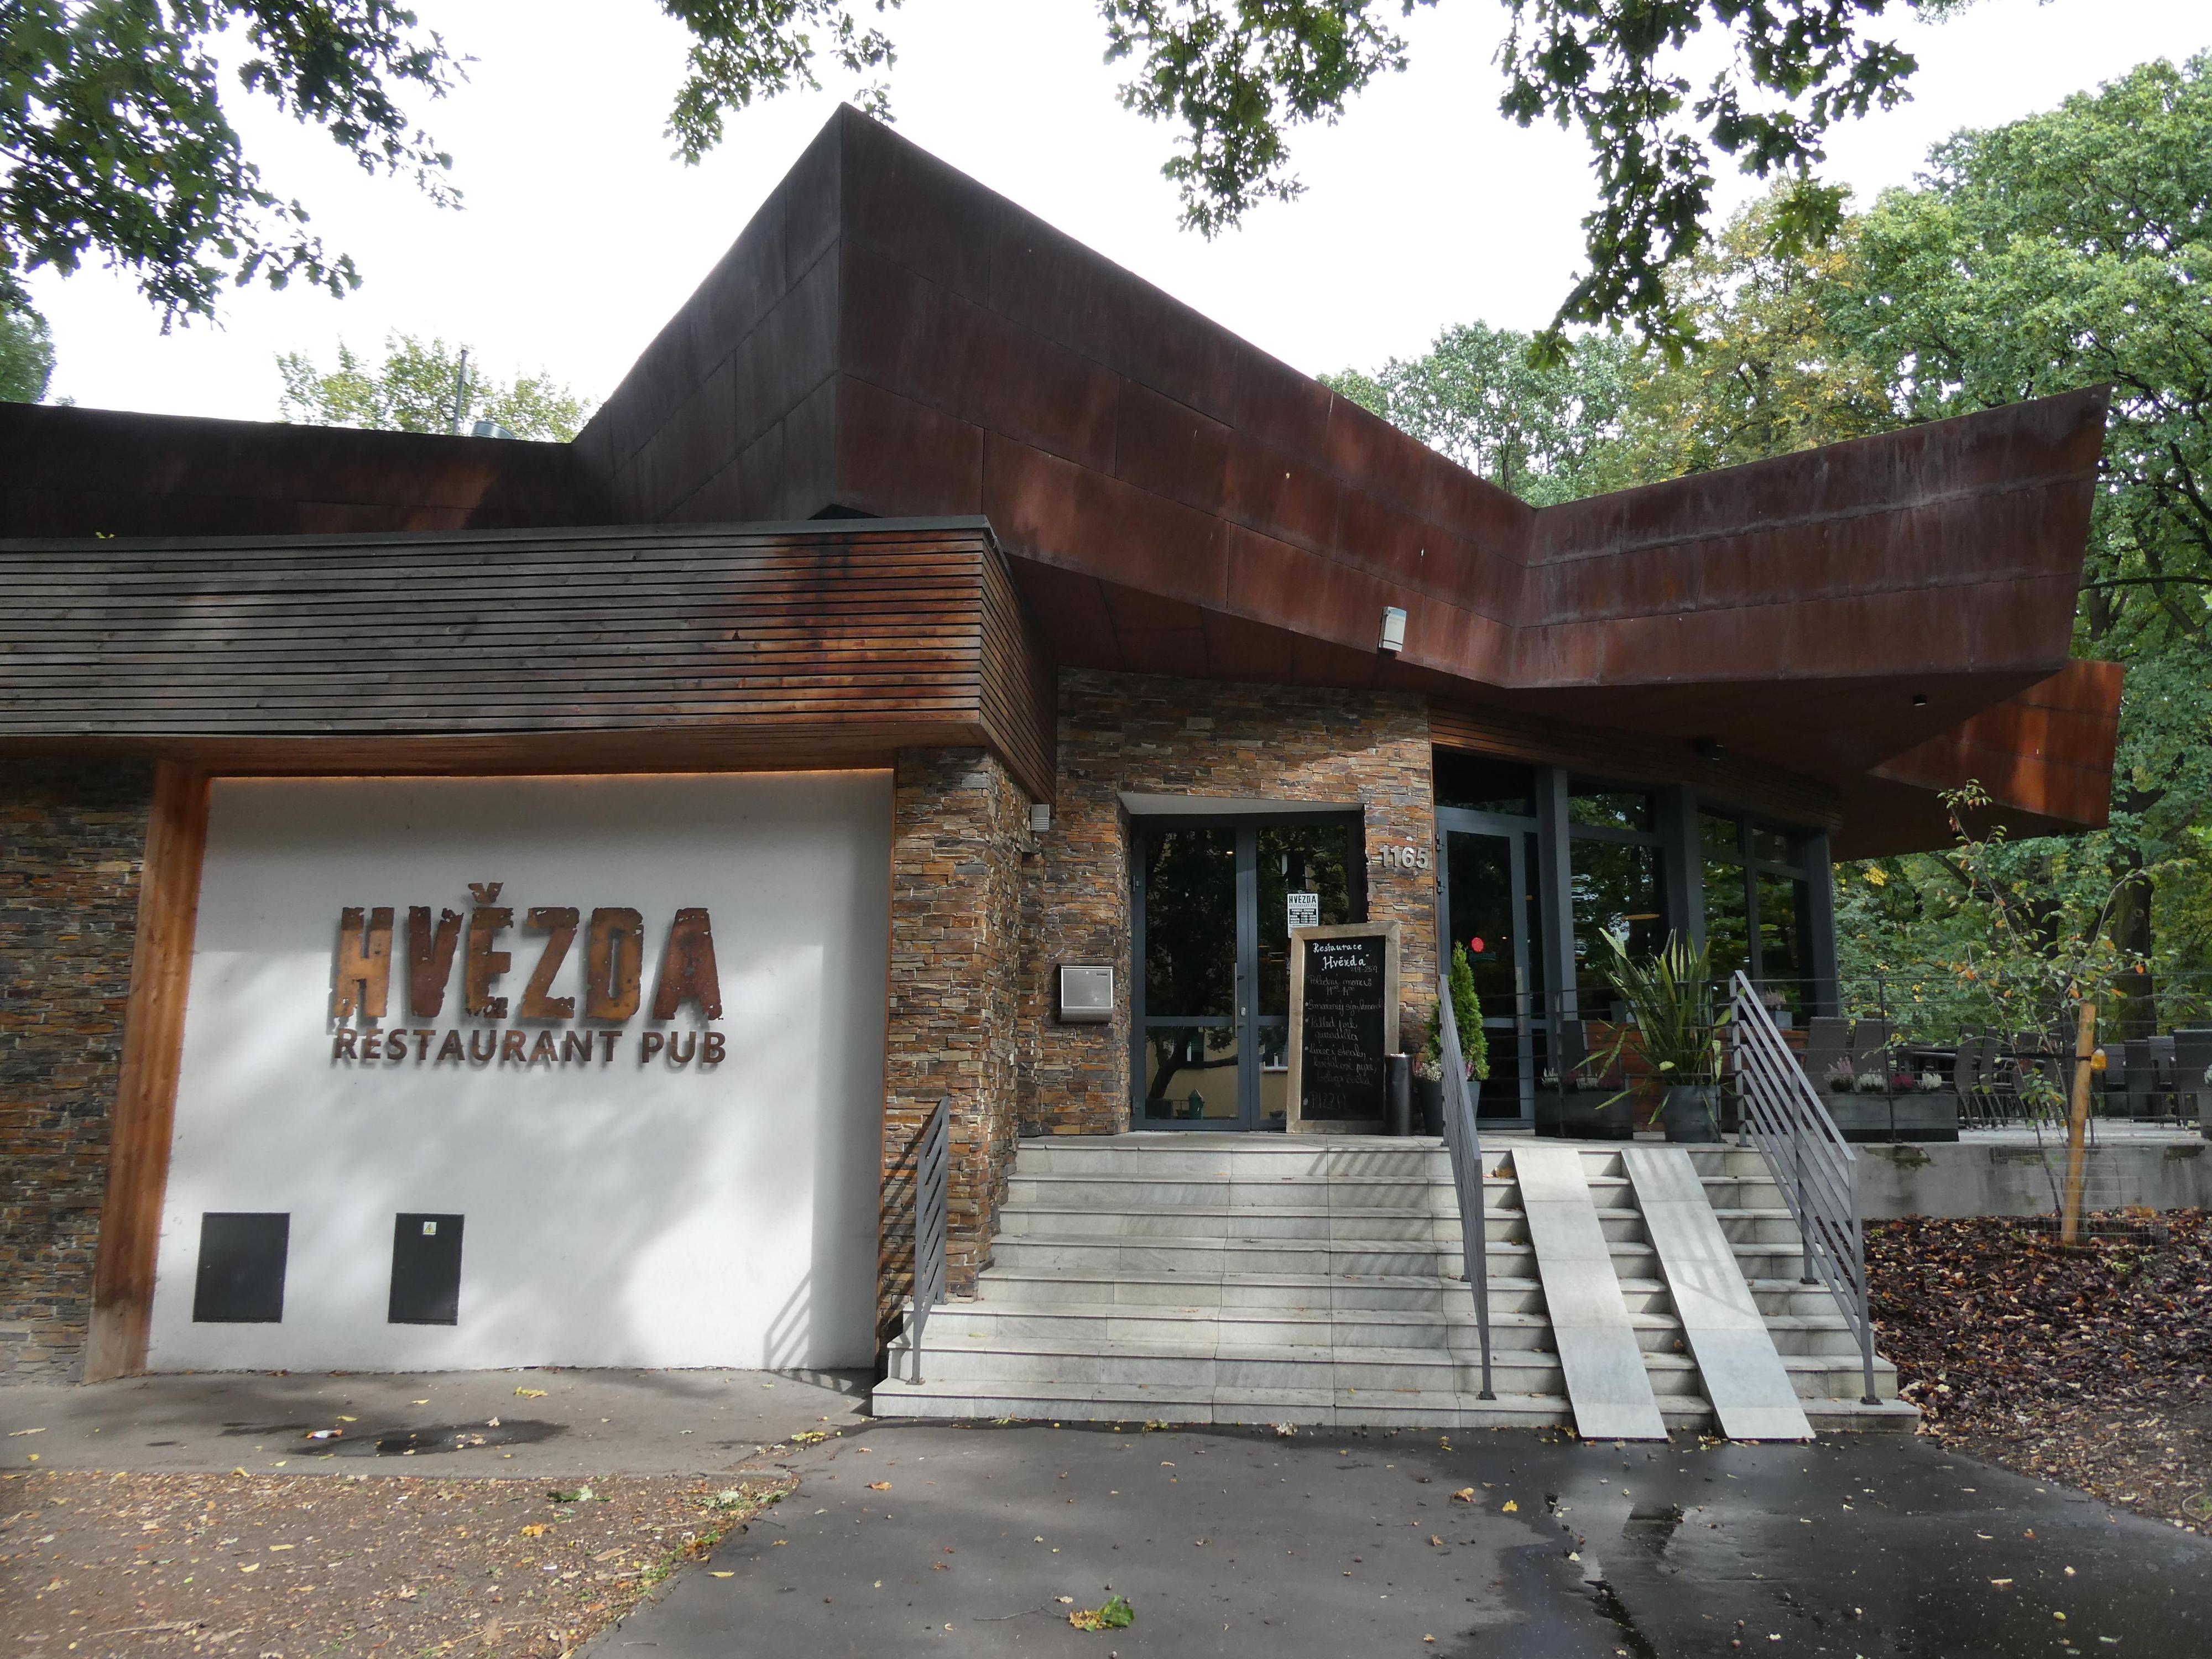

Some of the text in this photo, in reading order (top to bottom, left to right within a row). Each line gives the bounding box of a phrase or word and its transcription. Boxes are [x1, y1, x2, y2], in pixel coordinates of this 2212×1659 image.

[1379, 845, 1429, 869] 1165
[333, 881, 724, 1020] HVĚZDA
[1312, 942, 1363, 953] Restaurace
[334, 1027, 727, 1064] RESTAURANT PUB
